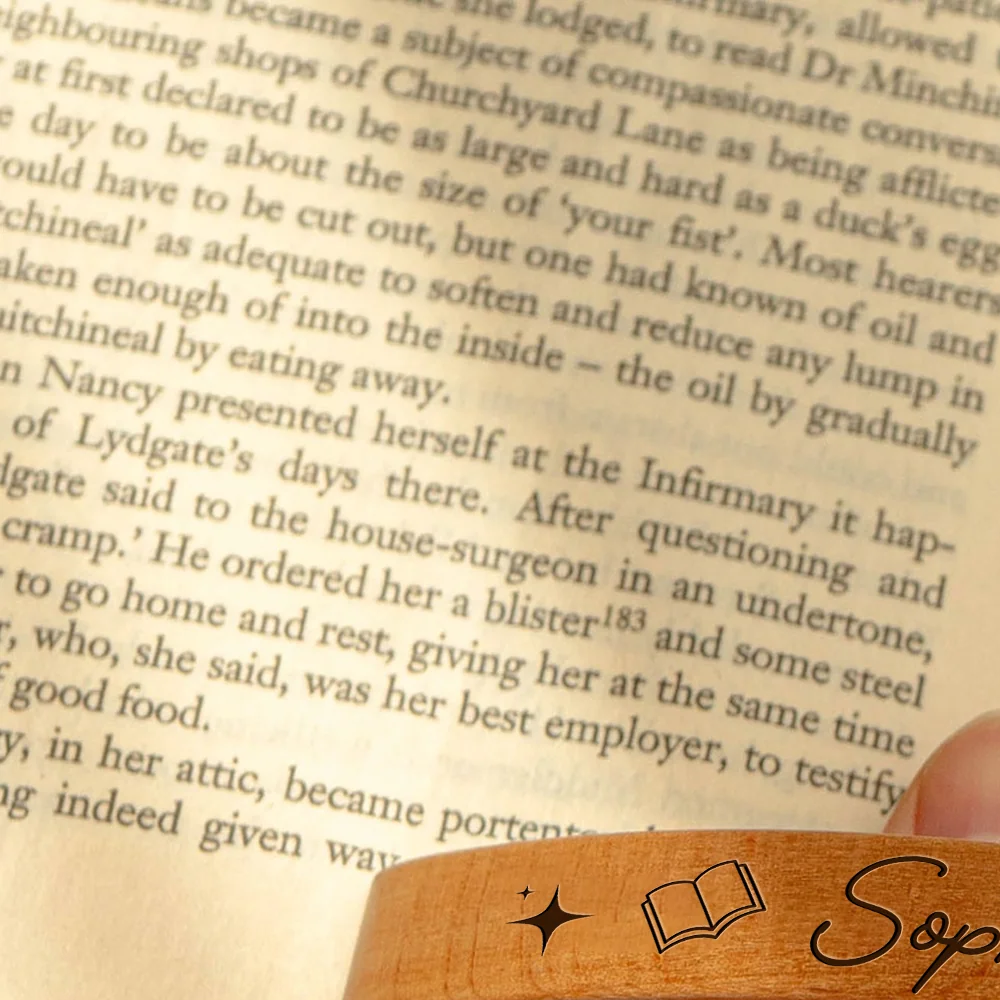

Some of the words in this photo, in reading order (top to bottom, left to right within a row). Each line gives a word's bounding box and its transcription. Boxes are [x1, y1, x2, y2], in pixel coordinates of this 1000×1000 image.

[215, 35, 318, 87] shops
[330, 58, 378, 91] of
[381, 64, 603, 134] Churchyard
[612, 105, 706, 156] Lane
[716, 137, 754, 164] as
[766, 135, 869, 197] being
[522, 0, 655, 52] lodged,
[666, 28, 706, 58] to
[711, 39, 794, 77] read
[800, 47, 855, 88] Dr
[29, 101, 96, 151] day
[110, 122, 149, 150] to
[164, 121, 209, 161] be
[223, 134, 329, 182] about
[344, 155, 404, 194] the
[417, 178, 487, 211] size
[502, 186, 549, 220] of
[760, 234, 859, 285] Most
[38, 355, 164, 416] Nancy
[173, 388, 359, 440] presented
[371, 408, 506, 462] herself
[511, 445, 548, 473] at
[562, 443, 622, 485] the
[638, 456, 817, 535] Infirmary
[829, 498, 859, 537] it
[871, 507, 956, 564] hap-
[91, 274, 229, 321] enough
[243, 292, 285, 324] of
[294, 305, 371, 338] into
[384, 310, 443, 353] the
[455, 332, 565, 374] inside
[615, 352, 675, 394] the
[686, 371, 738, 408] oil
[749, 378, 796, 428] by
[804, 403, 978, 471] gradually
[11, 406, 59, 441] of
[277, 447, 359, 498] days
[385, 464, 489, 515] there.
[515, 490, 615, 535] After
[636, 519, 856, 596] questioning
[877, 572, 948, 611] and
[101, 477, 178, 514] said
[193, 493, 231, 522] to
[250, 495, 310, 537] the
[325, 505, 599, 587] house-surgeon
[616, 557, 653, 596] in
[670, 577, 715, 608] an
[735, 590, 933, 665] undertone,
[151, 530, 211, 573] He
[220, 549, 370, 600] ordered
[376, 567, 443, 611] her
[450, 593, 470, 619] a
[653, 624, 726, 661] and
[732, 642, 832, 686] some
[840, 669, 926, 710] steel
[34, 619, 120, 669] who,
[132, 634, 197, 676] she
[206, 651, 289, 698] said,
[304, 672, 372, 706] was
[380, 673, 448, 721] her
[457, 689, 535, 737] best
[543, 714, 729, 774] employer,
[744, 746, 783, 778] to
[794, 758, 904, 817] testify
[46, 726, 84, 766] in
[97, 732, 164, 778] her
[174, 756, 266, 804] attic,
[283, 764, 426, 828] became
[52, 780, 184, 837] indeed
[197, 810, 303, 859] given
